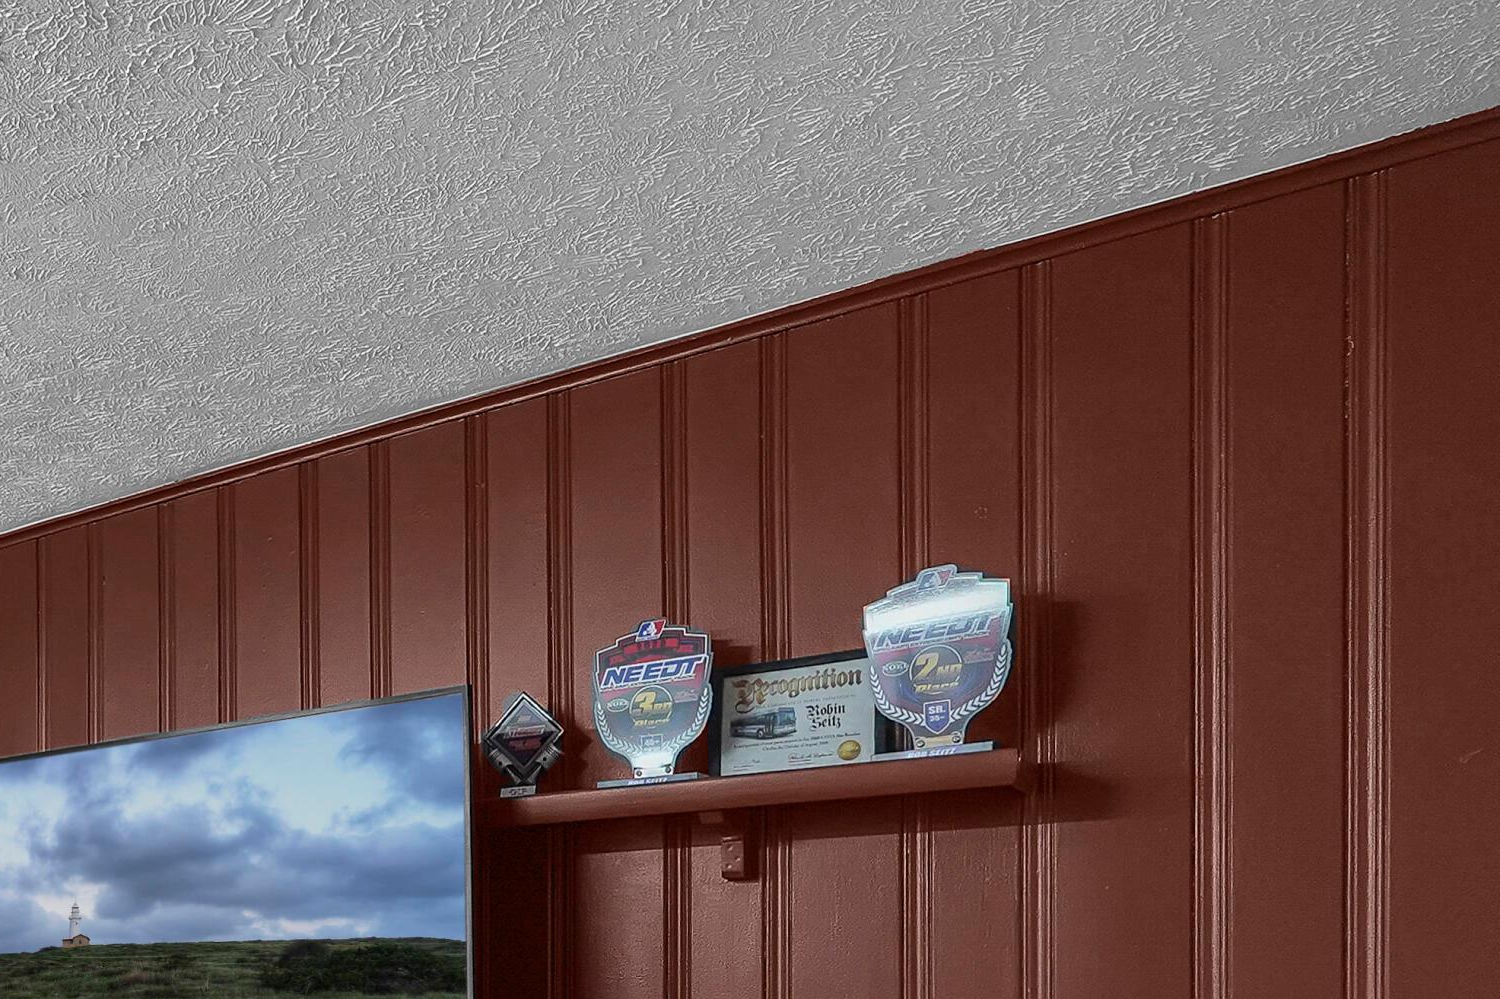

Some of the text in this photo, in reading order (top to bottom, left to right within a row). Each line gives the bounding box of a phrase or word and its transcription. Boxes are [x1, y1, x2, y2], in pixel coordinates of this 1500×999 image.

[875, 612, 1002, 648] NEEDT
[602, 658, 703, 687] NEEDT
[913, 652, 963, 680] 2ND
[633, 691, 673, 715] 3RD
[731, 668, 862, 713] Recognition
[805, 703, 846, 719] Robin
[810, 715, 842, 731] Seitz
